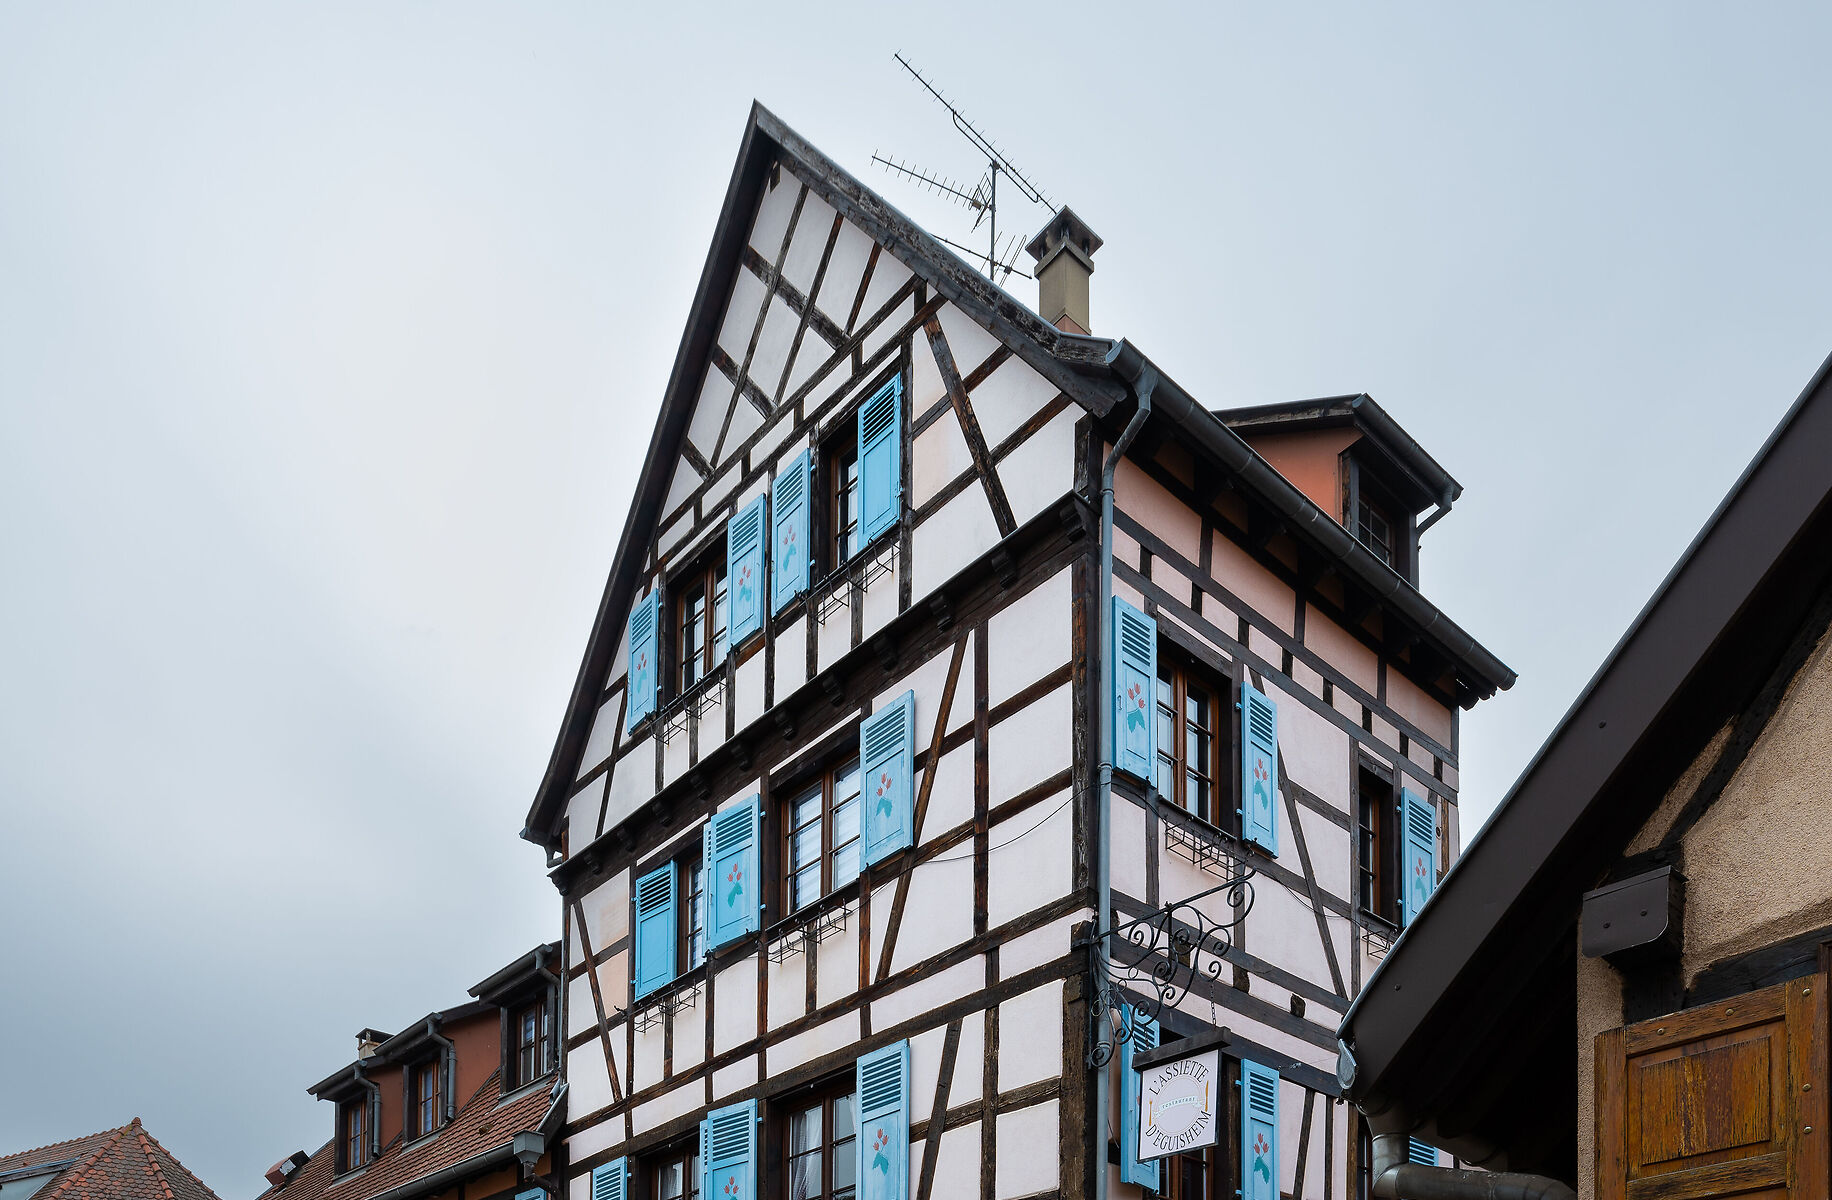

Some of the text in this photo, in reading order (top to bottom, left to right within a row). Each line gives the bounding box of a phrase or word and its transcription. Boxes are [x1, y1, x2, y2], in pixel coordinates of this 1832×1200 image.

[1149, 1060, 1210, 1095] L'ASSIETTE
[1162, 1097, 1195, 1109] restaurant
[1145, 1110, 1212, 1151] D'EGUISHEIM
